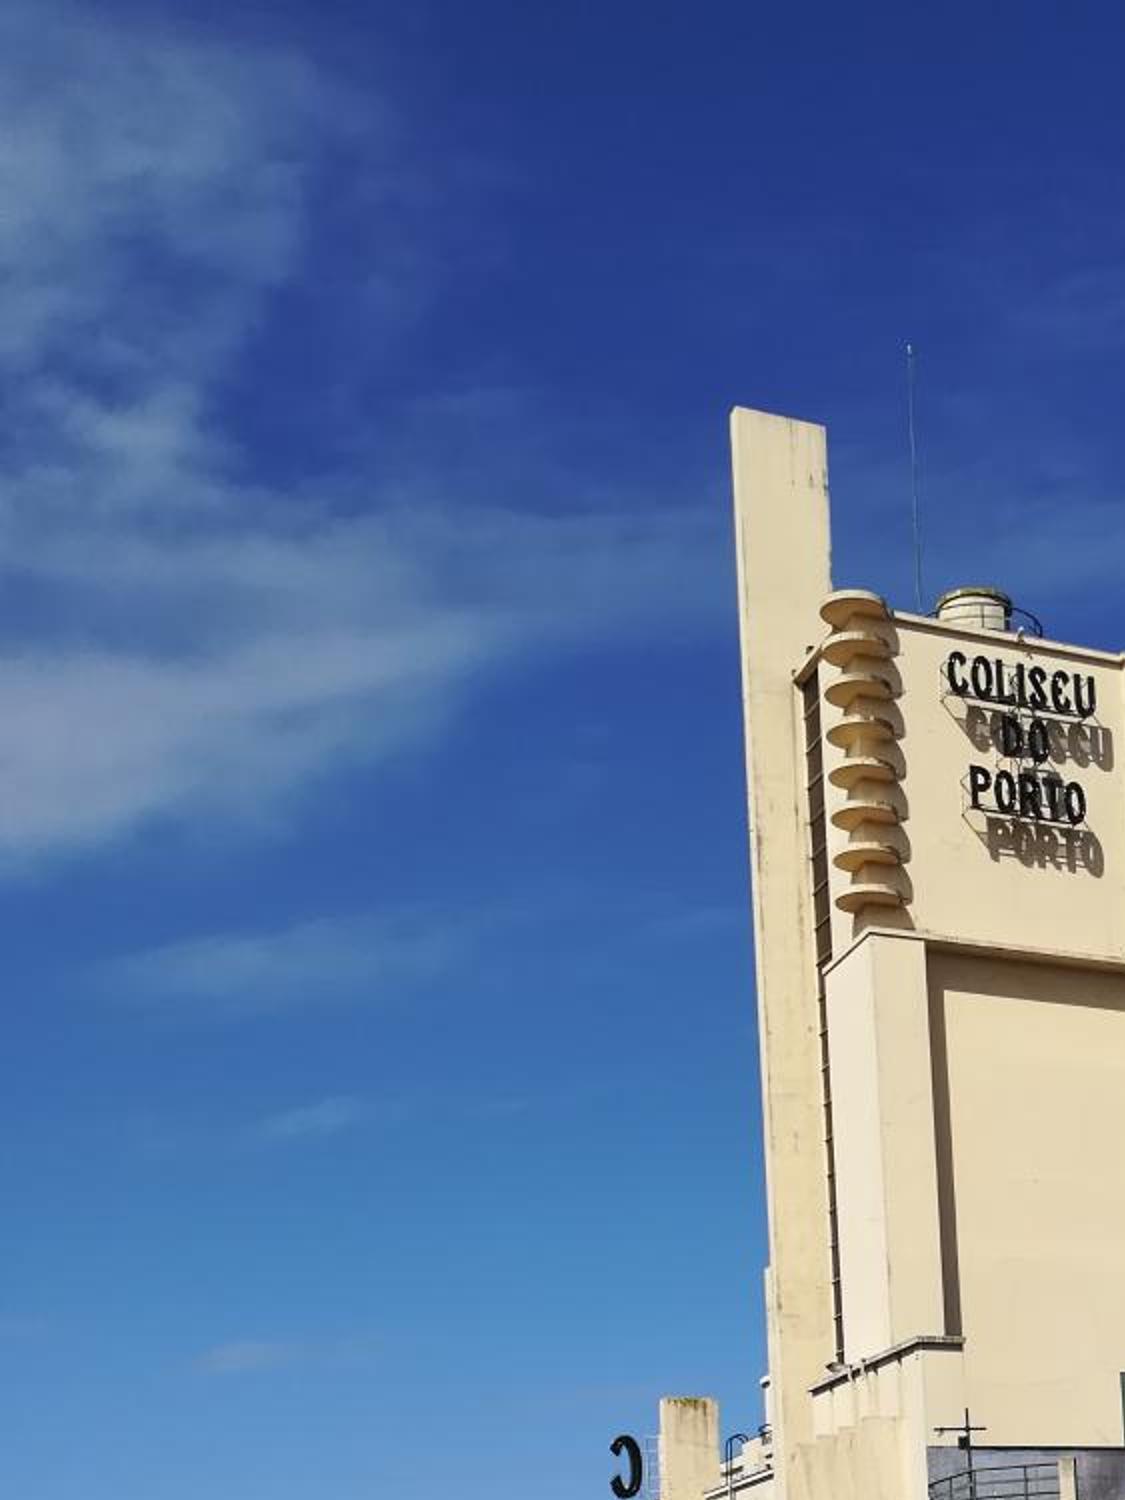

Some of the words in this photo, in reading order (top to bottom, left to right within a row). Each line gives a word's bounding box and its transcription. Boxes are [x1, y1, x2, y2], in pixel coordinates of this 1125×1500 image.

[948, 651, 1095, 717] COLISEU
[1001, 717, 1049, 763] DO
[969, 765, 1087, 826] PORTO
